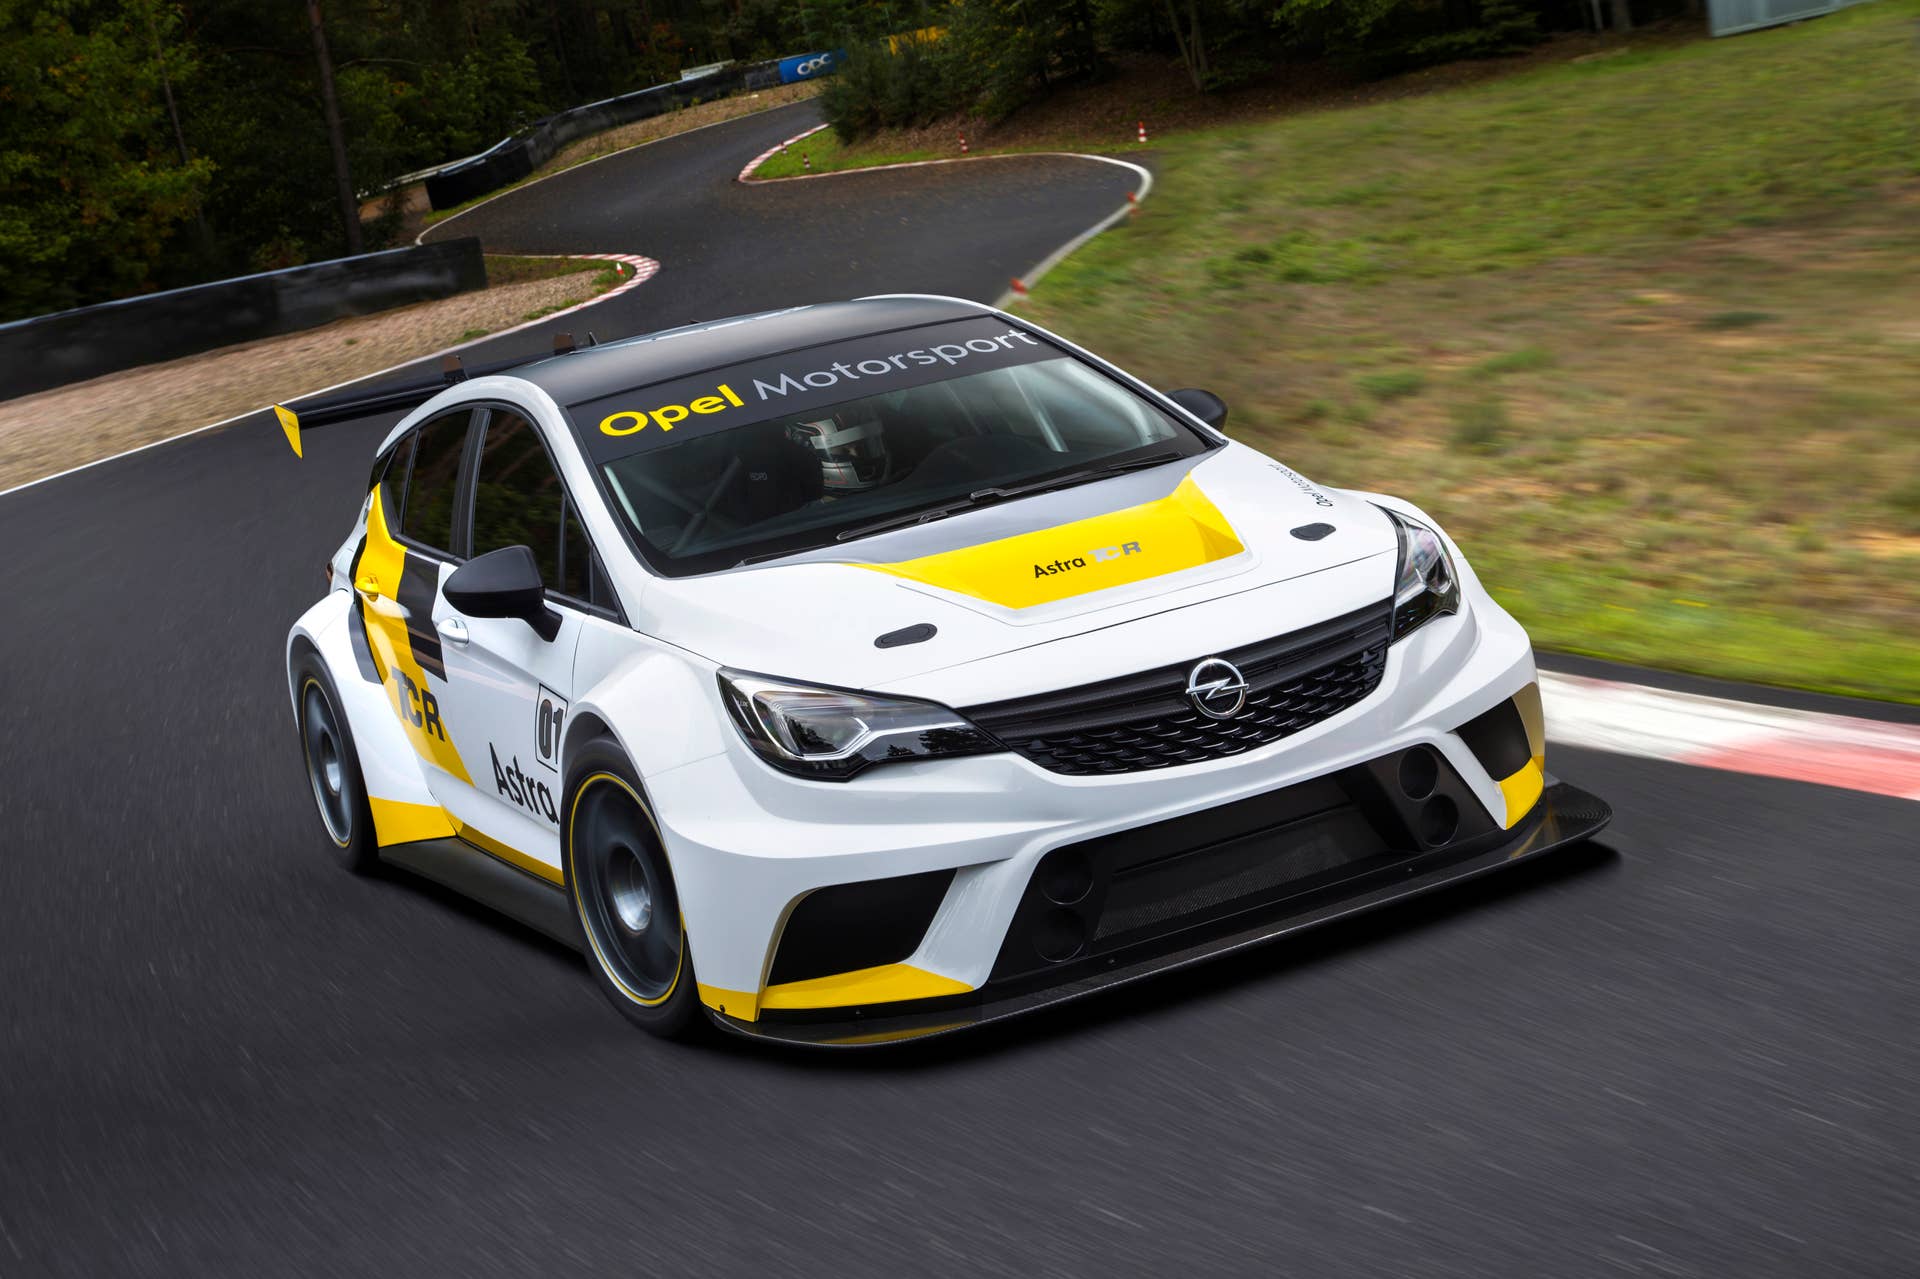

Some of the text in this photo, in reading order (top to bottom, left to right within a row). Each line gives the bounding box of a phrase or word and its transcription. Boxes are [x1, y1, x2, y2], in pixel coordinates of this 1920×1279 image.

[599, 328, 1038, 438] Opel Motorsport
[1034, 541, 1142, 579] Astra TCR
[391, 666, 445, 742] TCR
[539, 698, 564, 766] 01
[489, 741, 560, 825] Astra
